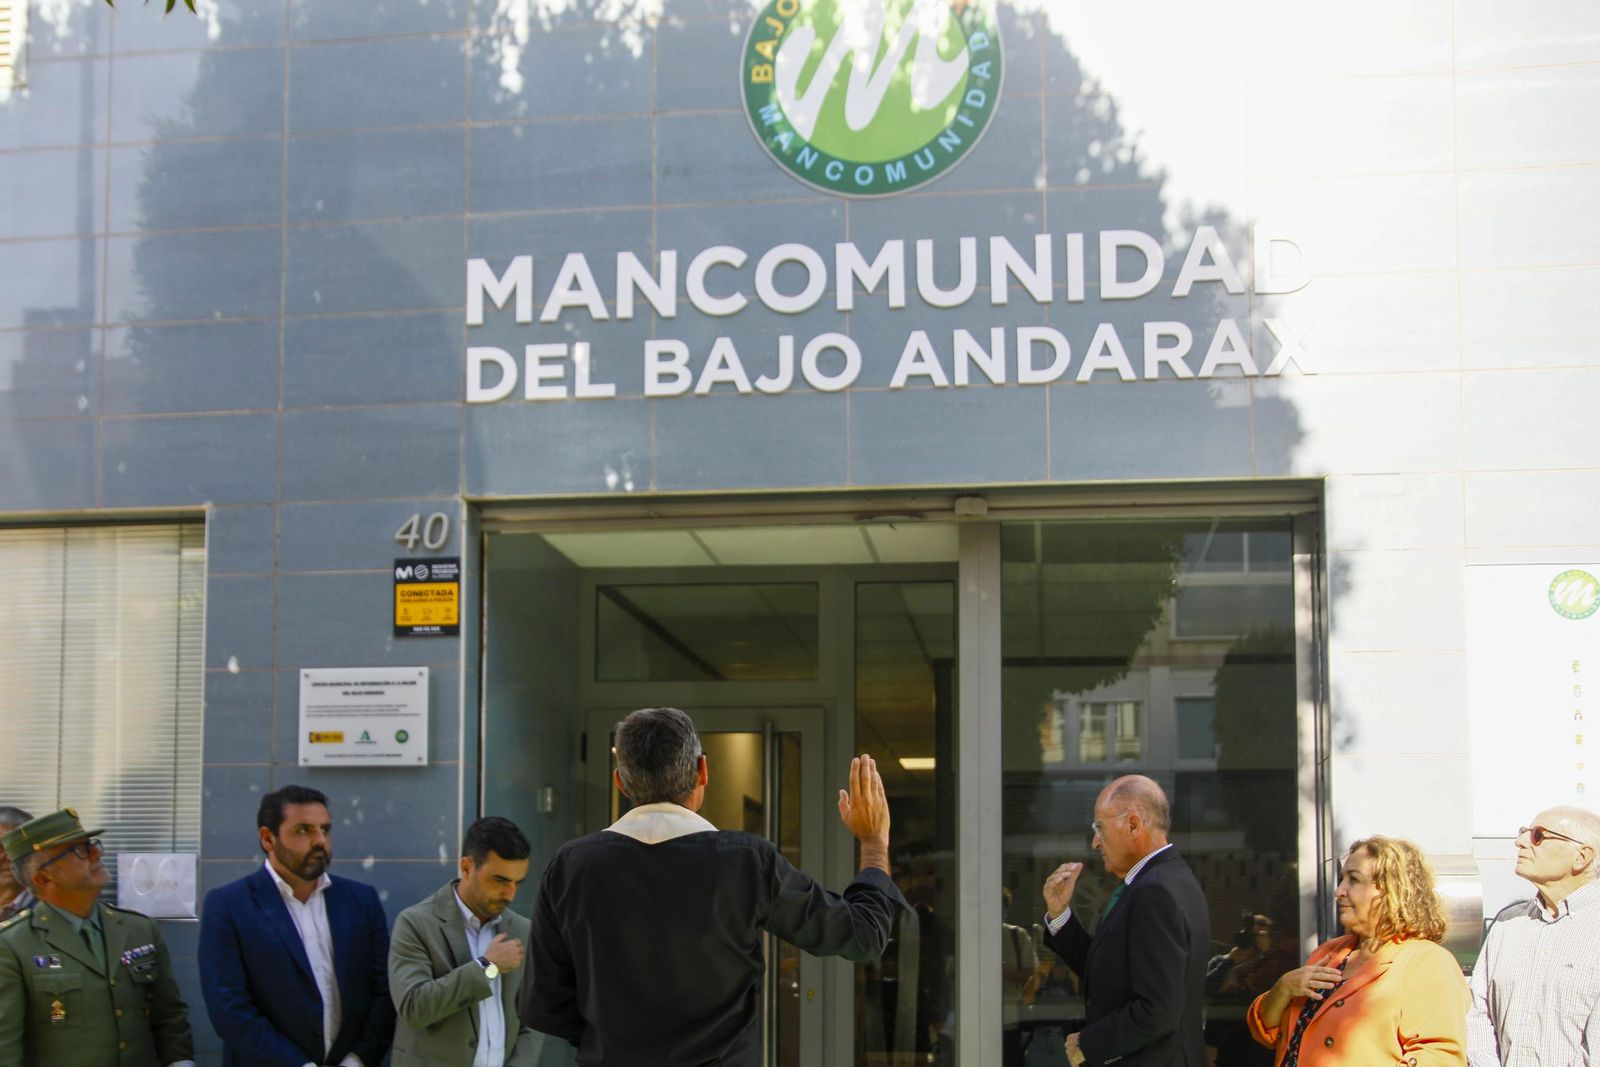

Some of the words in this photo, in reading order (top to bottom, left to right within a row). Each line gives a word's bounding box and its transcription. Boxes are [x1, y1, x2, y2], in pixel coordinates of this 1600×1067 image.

[752, 0, 799, 84] BAJO
[757, 31, 992, 186] MANCOMUNIDAD
[466, 225, 1313, 326] MANCOMUNIDAD
[466, 341, 616, 403] DEL
[644, 332, 862, 397] BAJO
[889, 317, 1318, 388] ANDARAX
[394, 511, 449, 550] 40
[400, 589, 454, 597] CONECTADA
